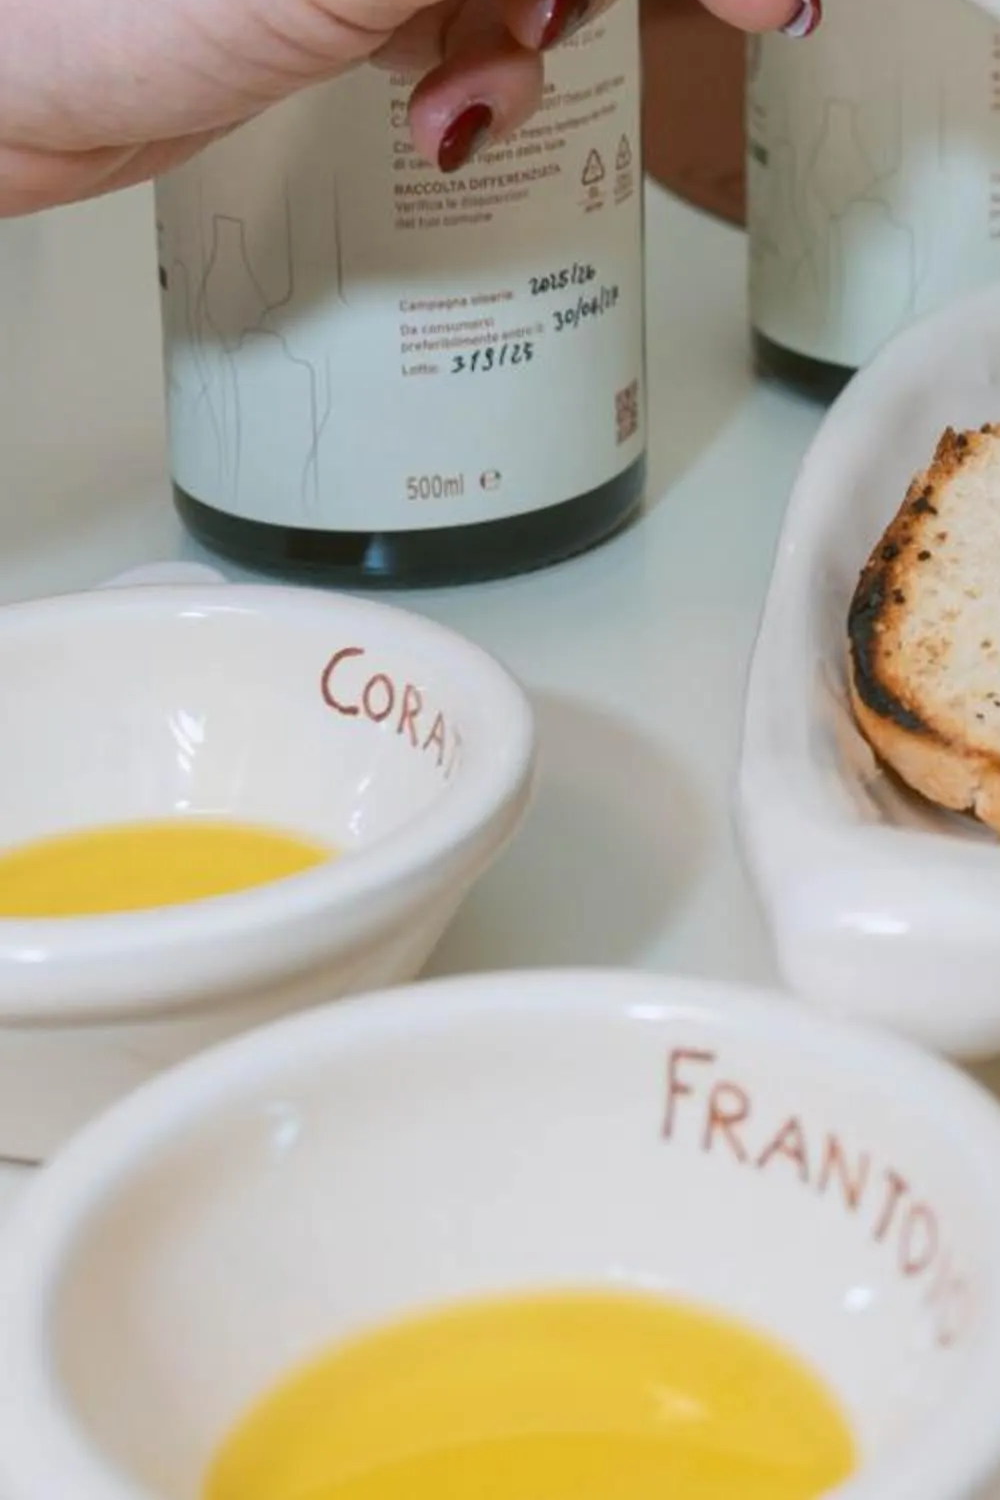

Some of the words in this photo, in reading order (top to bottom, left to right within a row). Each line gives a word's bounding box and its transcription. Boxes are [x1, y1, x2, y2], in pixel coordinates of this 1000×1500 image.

[393, 179, 466, 196] RACCOLTA
[469, 163, 562, 191] DIFFERENZIATA
[395, 198, 443, 212] Verifica
[400, 297, 467, 312] Campagna
[401, 323, 418, 337] Da
[401, 331, 499, 353] preferibilmente
[407, 473, 465, 501] 500ml
